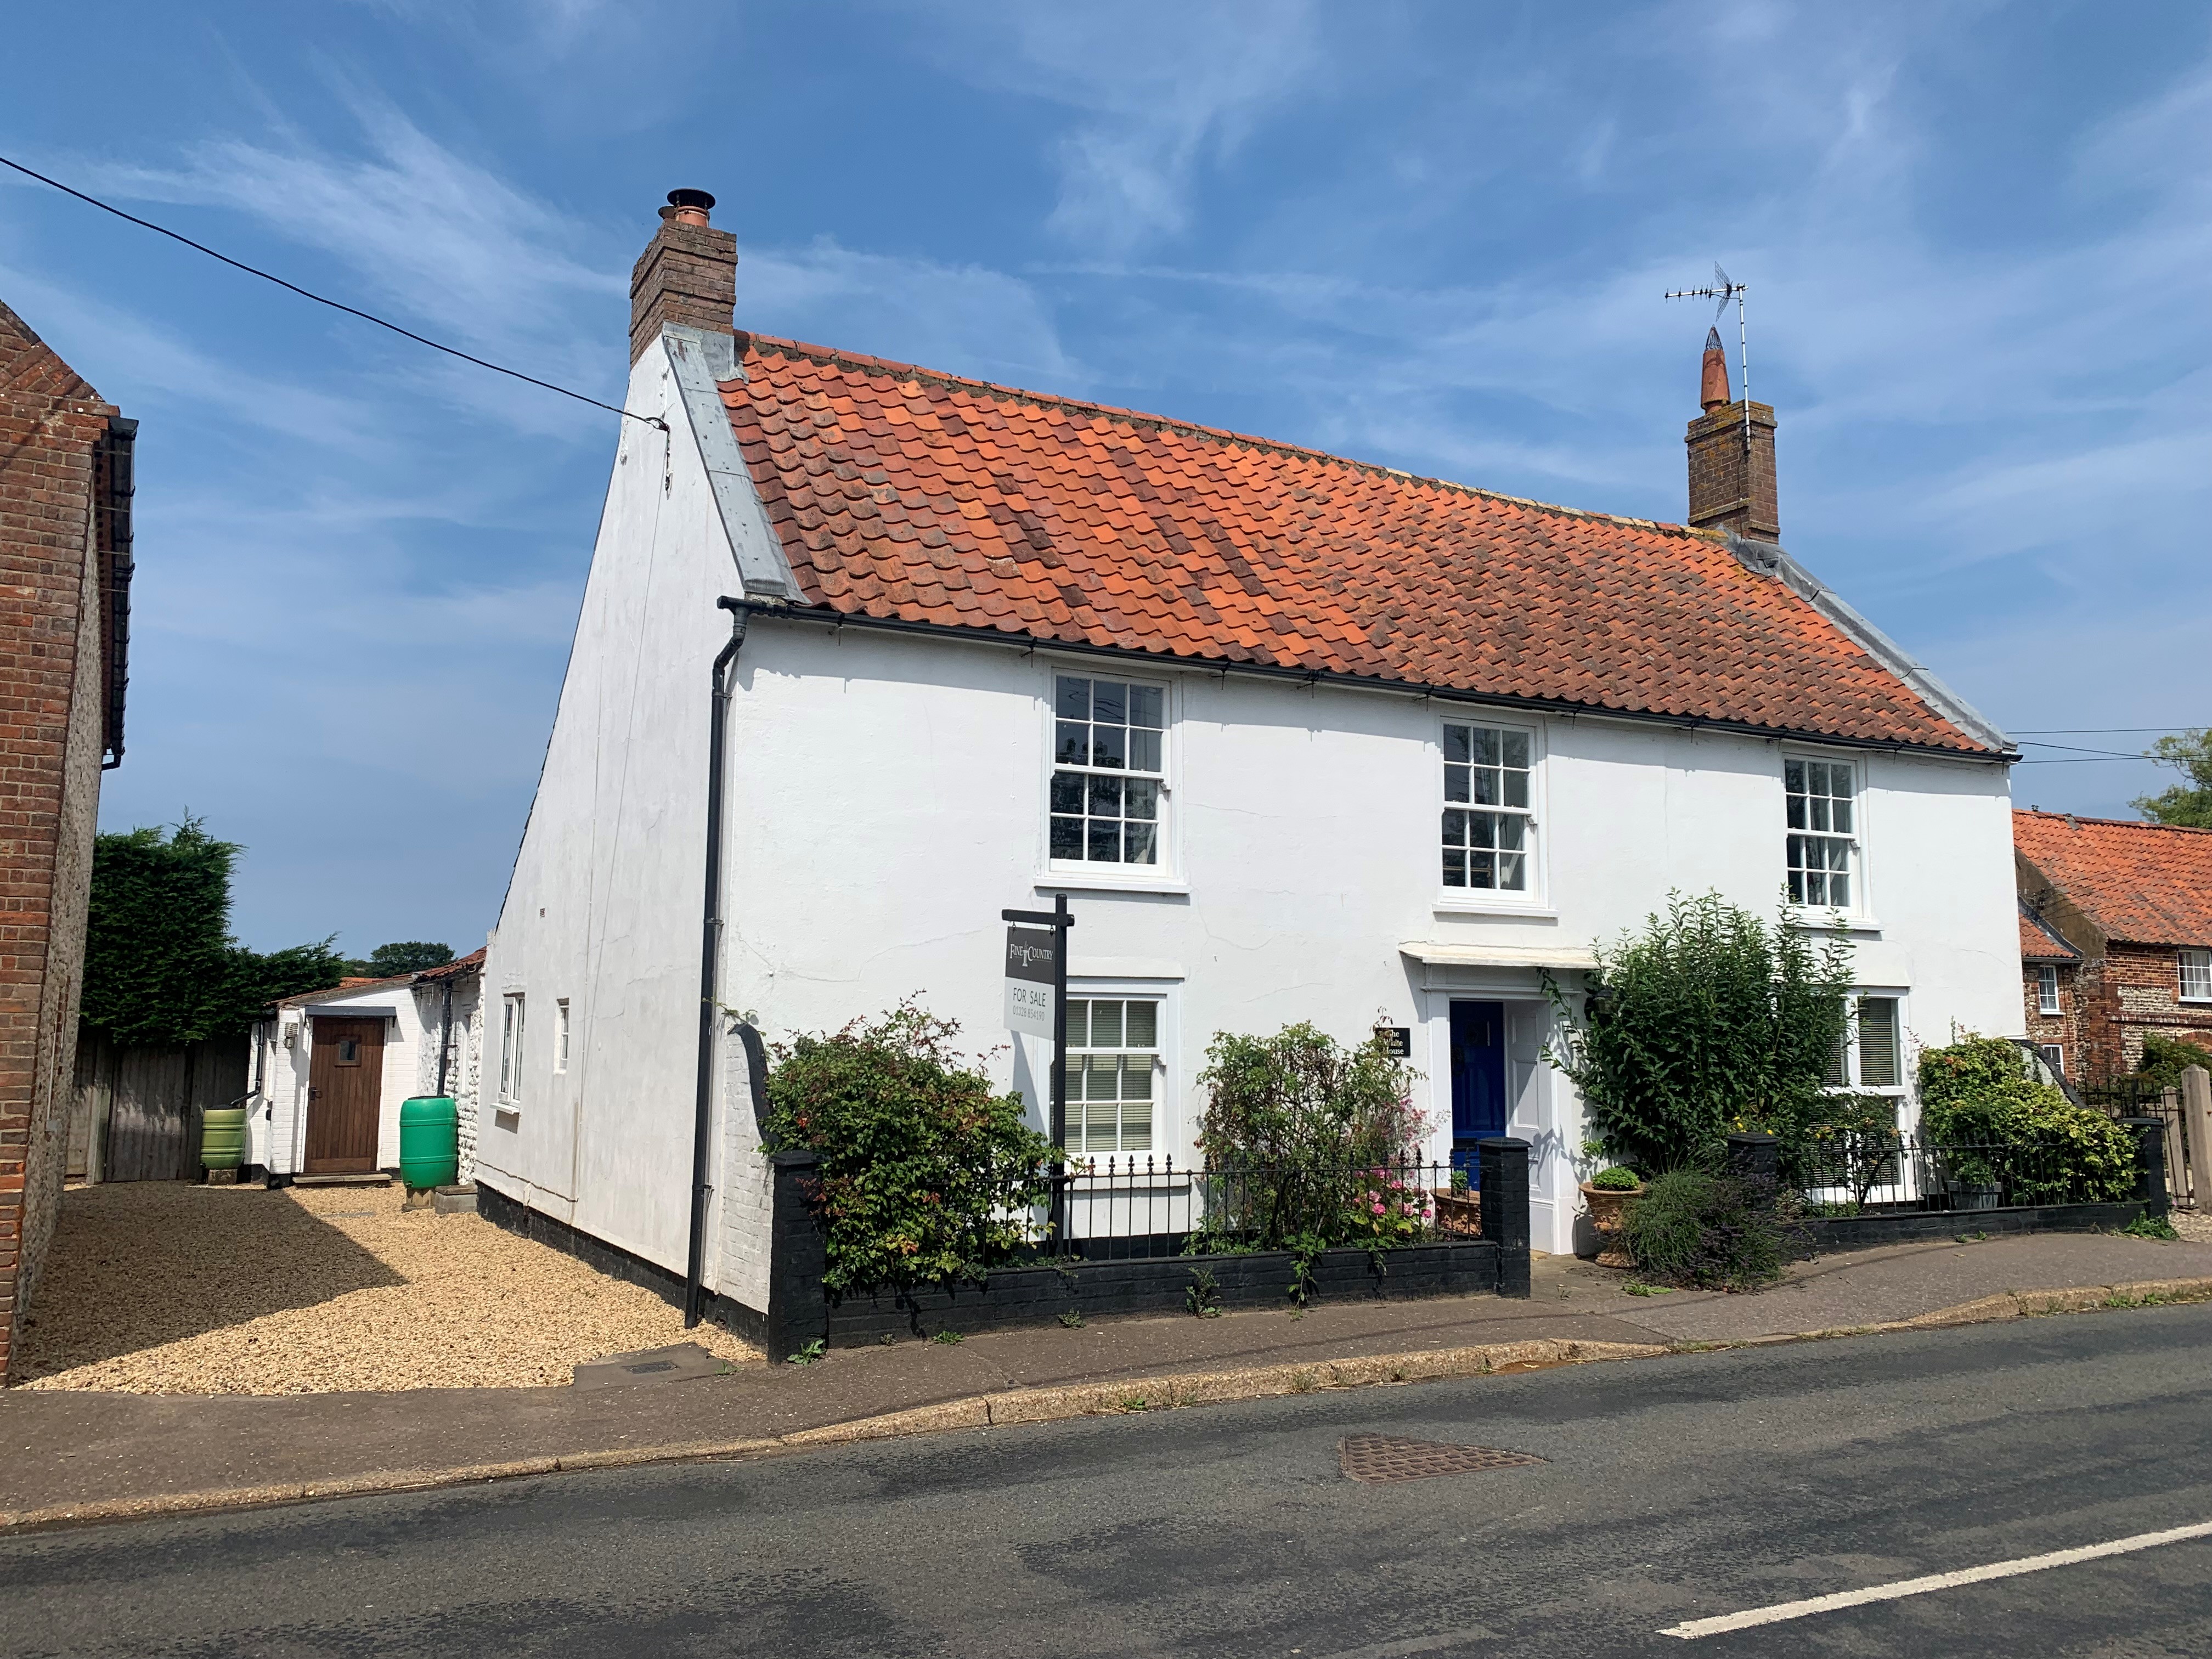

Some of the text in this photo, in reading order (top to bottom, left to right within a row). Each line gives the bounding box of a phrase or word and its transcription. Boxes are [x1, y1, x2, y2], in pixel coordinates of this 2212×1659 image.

[1010, 944, 1053, 962] FINE COUNTRY
[1013, 988, 1046, 1007] FOR SALE
[1013, 1005, 1045, 1022] 01328 854190
[1383, 1037, 1403, 1046] Whe
[1389, 1029, 1400, 1037] he
